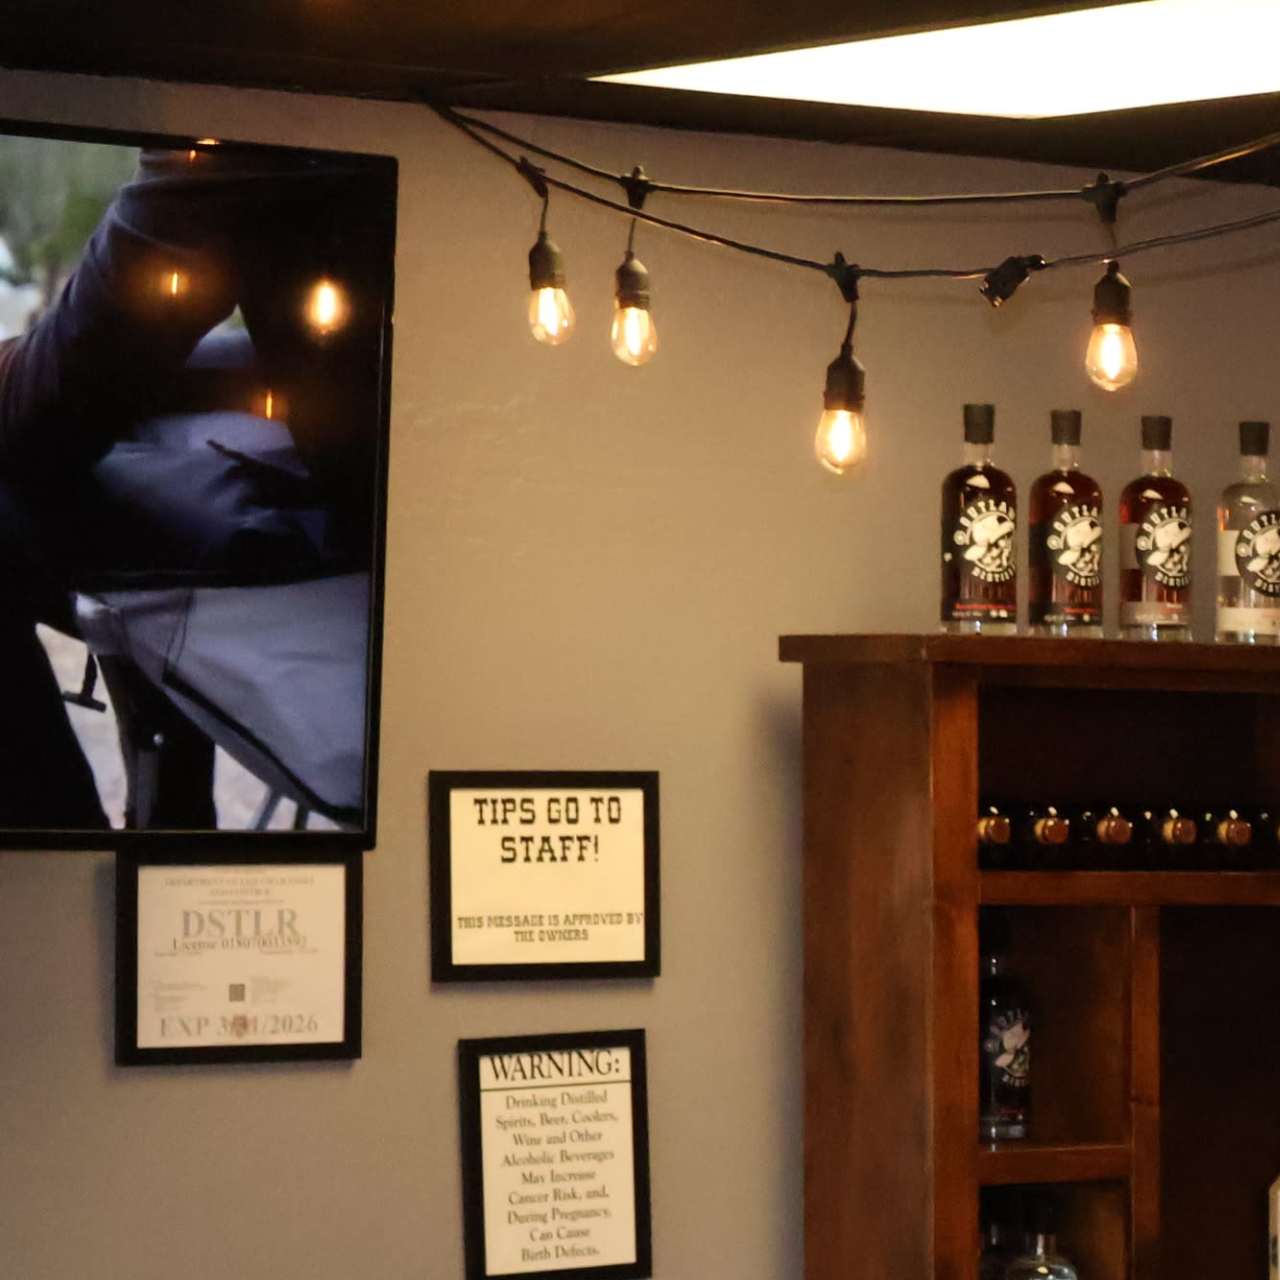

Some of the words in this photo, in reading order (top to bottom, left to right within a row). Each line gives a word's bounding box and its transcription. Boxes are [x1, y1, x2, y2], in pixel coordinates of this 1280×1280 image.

[1053, 504, 1098, 530] OUTLA
[1142, 505, 1188, 533] OUTLA
[473, 797, 536, 825] TIPS
[547, 796, 579, 824] GO
[590, 796, 622, 823] TO
[501, 835, 599, 863] STAFF!
[182, 908, 300, 939] DSTLR
[457, 916, 484, 929] THIS
[487, 914, 545, 928] MESSAGE
[548, 914, 560, 927] IS
[563, 912, 623, 926] APPROVED
[626, 912, 644, 925] BY
[514, 930, 535, 942] THE
[538, 929, 589, 942] OWNERS
[160, 1016, 210, 1038] EXP
[490, 1048, 620, 1081] WARNING:
[505, 1094, 557, 1109] Drinking
[561, 1090, 608, 1106] Distilled
[513, 1133, 543, 1146] Wine
[546, 1131, 566, 1145] and
[569, 1129, 602, 1143] Other
[502, 1151, 553, 1167] Alcoholic
[560, 1148, 615, 1164] Beverages
[521, 1171, 545, 1185] May
[550, 1169, 596, 1183] Increase
[508, 1191, 548, 1205] Cancer
[507, 1210, 548, 1225] During
[530, 1228, 553, 1242] Can
[557, 1226, 590, 1240] Cause
[521, 1247, 551, 1262] Birth
